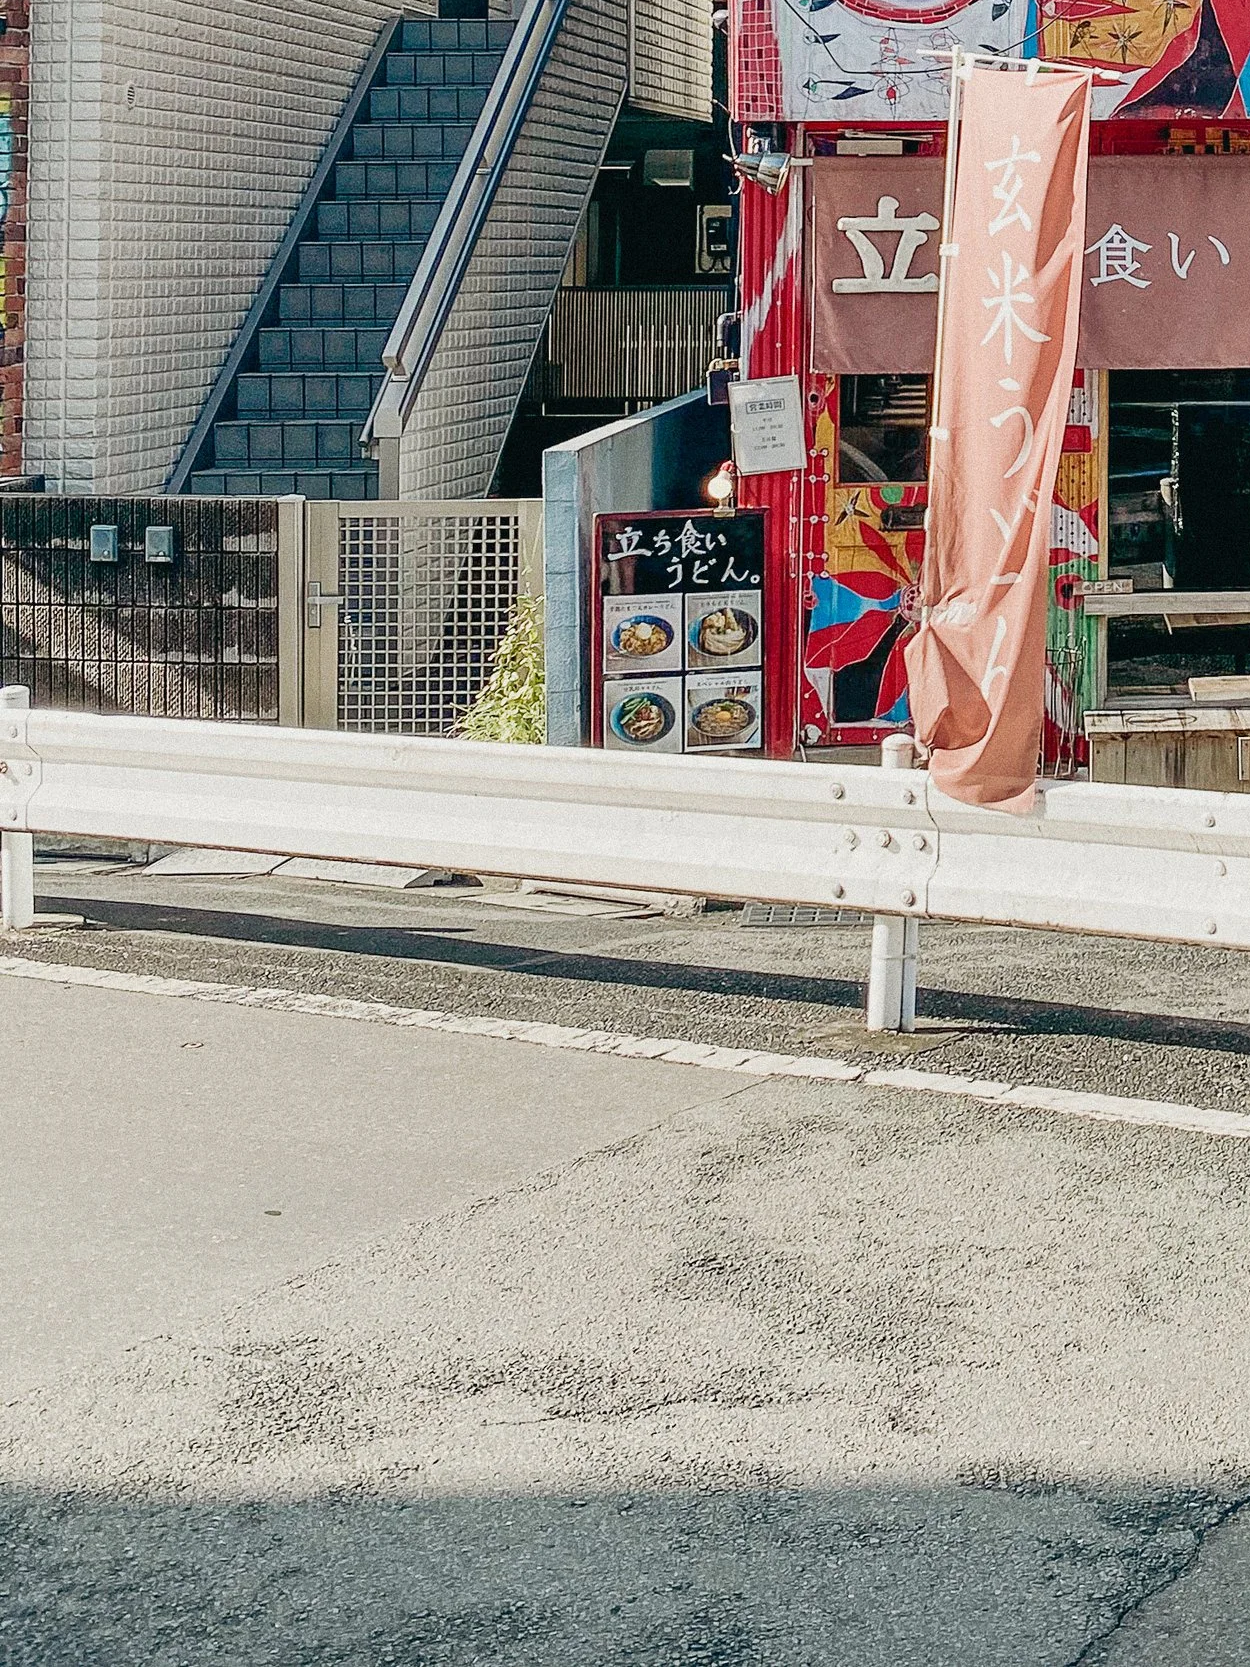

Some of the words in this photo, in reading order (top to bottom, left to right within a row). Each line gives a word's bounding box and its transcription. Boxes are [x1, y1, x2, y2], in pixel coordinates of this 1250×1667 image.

[608, 519, 728, 561] 立ち食い
[1082, 581, 1123, 593] OPEN
